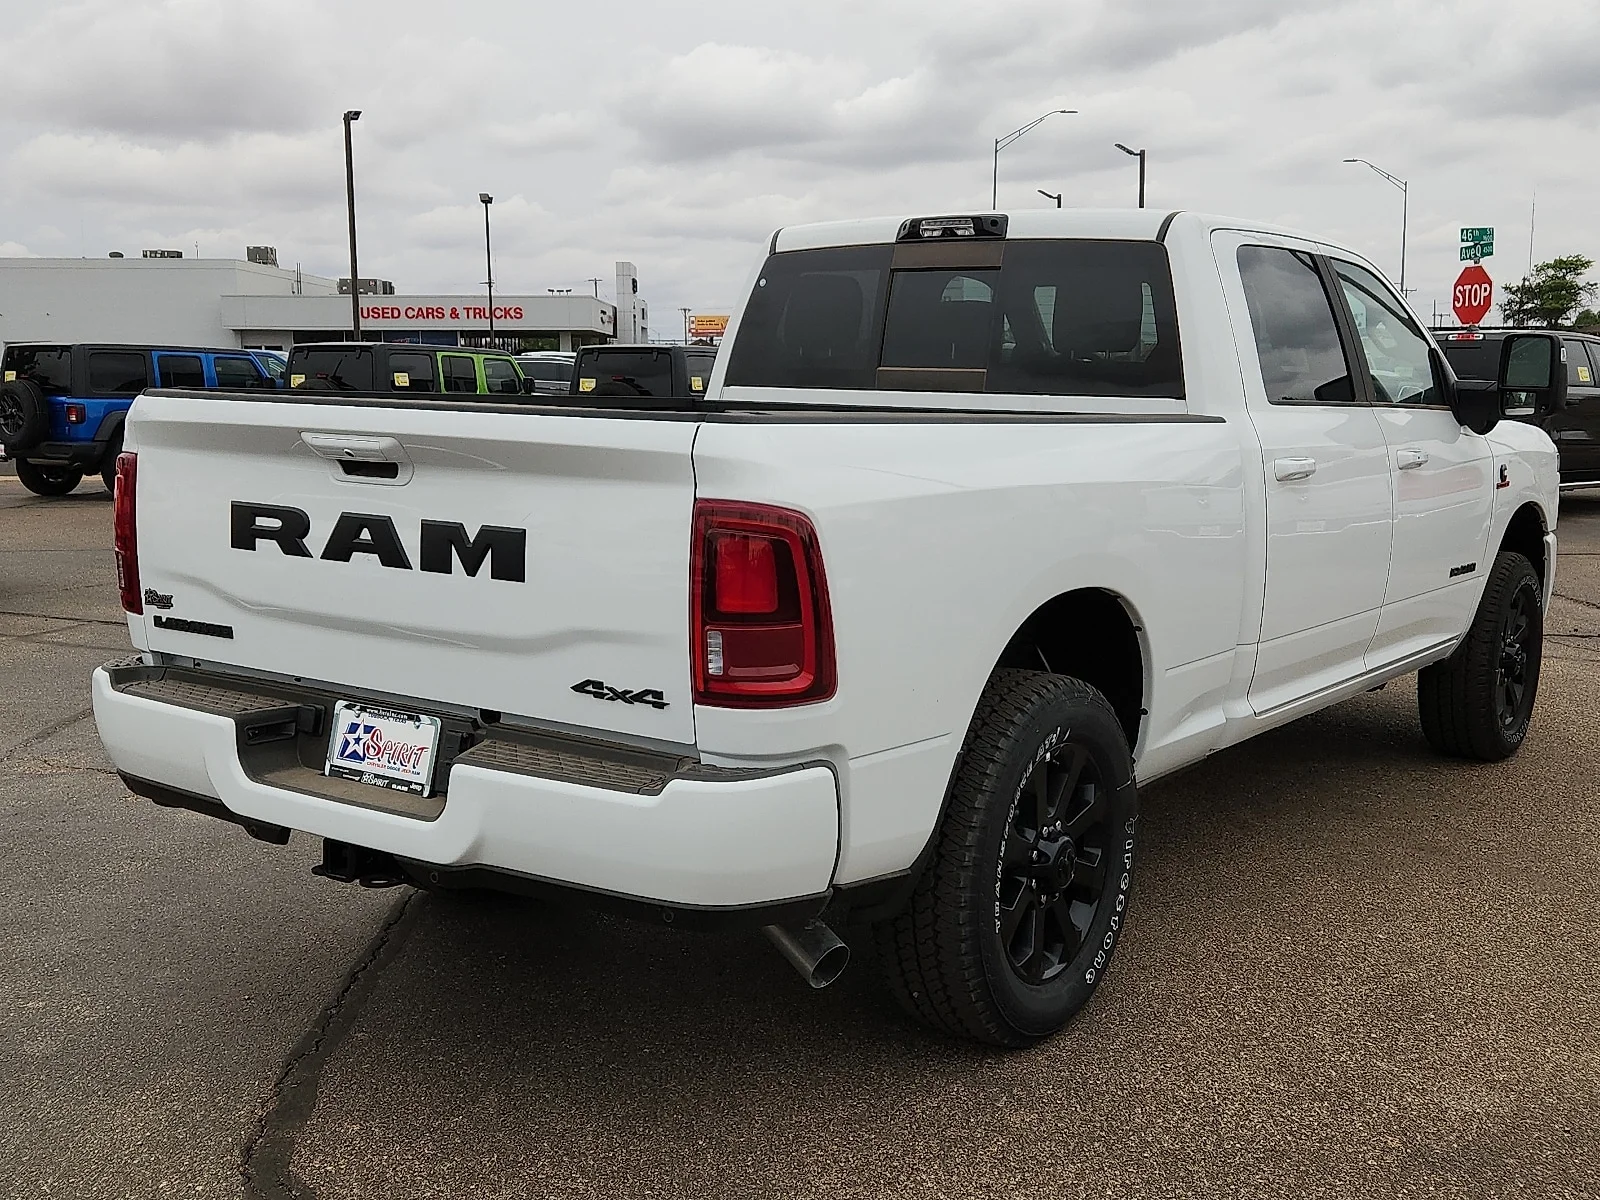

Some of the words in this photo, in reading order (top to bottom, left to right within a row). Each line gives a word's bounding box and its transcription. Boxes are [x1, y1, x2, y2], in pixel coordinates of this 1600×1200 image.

[1462, 229, 1480, 241] 46th
[1454, 283, 1491, 308] STOP
[360, 306, 401, 319] USED
[405, 306, 445, 319] CARS
[449, 307, 460, 319] &
[463, 306, 523, 319] TRUCKS
[230, 500, 527, 584] RAM
[570, 678, 670, 709] 4x4
